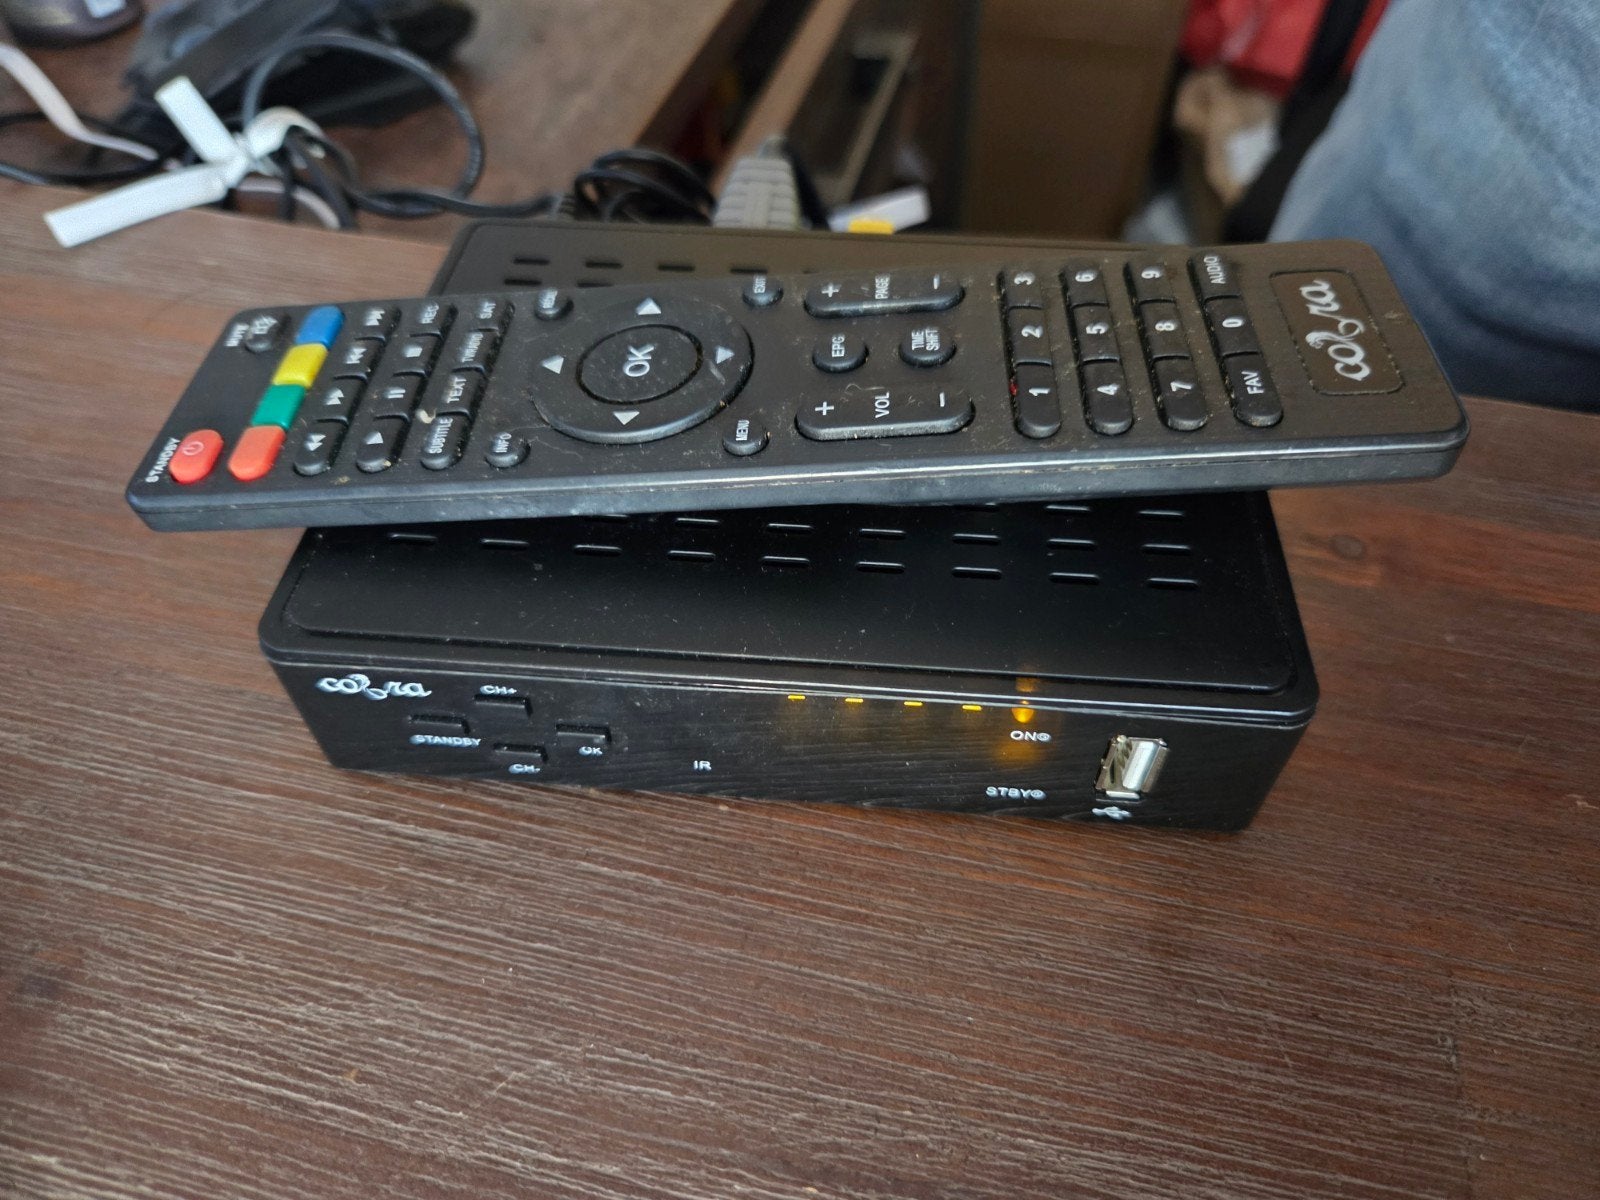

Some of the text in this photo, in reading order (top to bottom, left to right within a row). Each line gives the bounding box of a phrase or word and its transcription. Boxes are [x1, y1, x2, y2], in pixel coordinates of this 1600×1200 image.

[1014, 272, 1036, 285] 3
[1075, 269, 1097, 283] 6
[1141, 266, 1163, 279] 9
[1204, 255, 1226, 285] AUDIO
[754, 275, 768, 294] EXIT
[875, 274, 890, 299] PAGE
[421, 302, 440, 324] REC
[479, 301, 496, 319] SAT
[1086, 322, 1109, 335] 5
[1155, 320, 1178, 332] 8
[1222, 316, 1245, 329] 0
[912, 329, 925, 351] TIME
[925, 327, 941, 351] SHIFT
[1021, 325, 1043, 339] 2
[832, 334, 846, 357] EPG
[623, 344, 655, 377] OK
[447, 376, 467, 404] TEXT
[1097, 383, 1120, 396] 4
[1170, 380, 1195, 392] 7
[1241, 370, 1265, 395] FAV
[1028, 387, 1051, 397] 1
[875, 392, 890, 418] VOL
[428, 416, 453, 454] SUBTITLE
[736, 419, 750, 441] MENU
[494, 432, 512, 453] INFO
[145, 437, 181, 483] STANDBY
[479, 684, 518, 696] CH+
[409, 734, 482, 748] STANDBY
[578, 744, 604, 757] OK
[692, 759, 712, 771] IR
